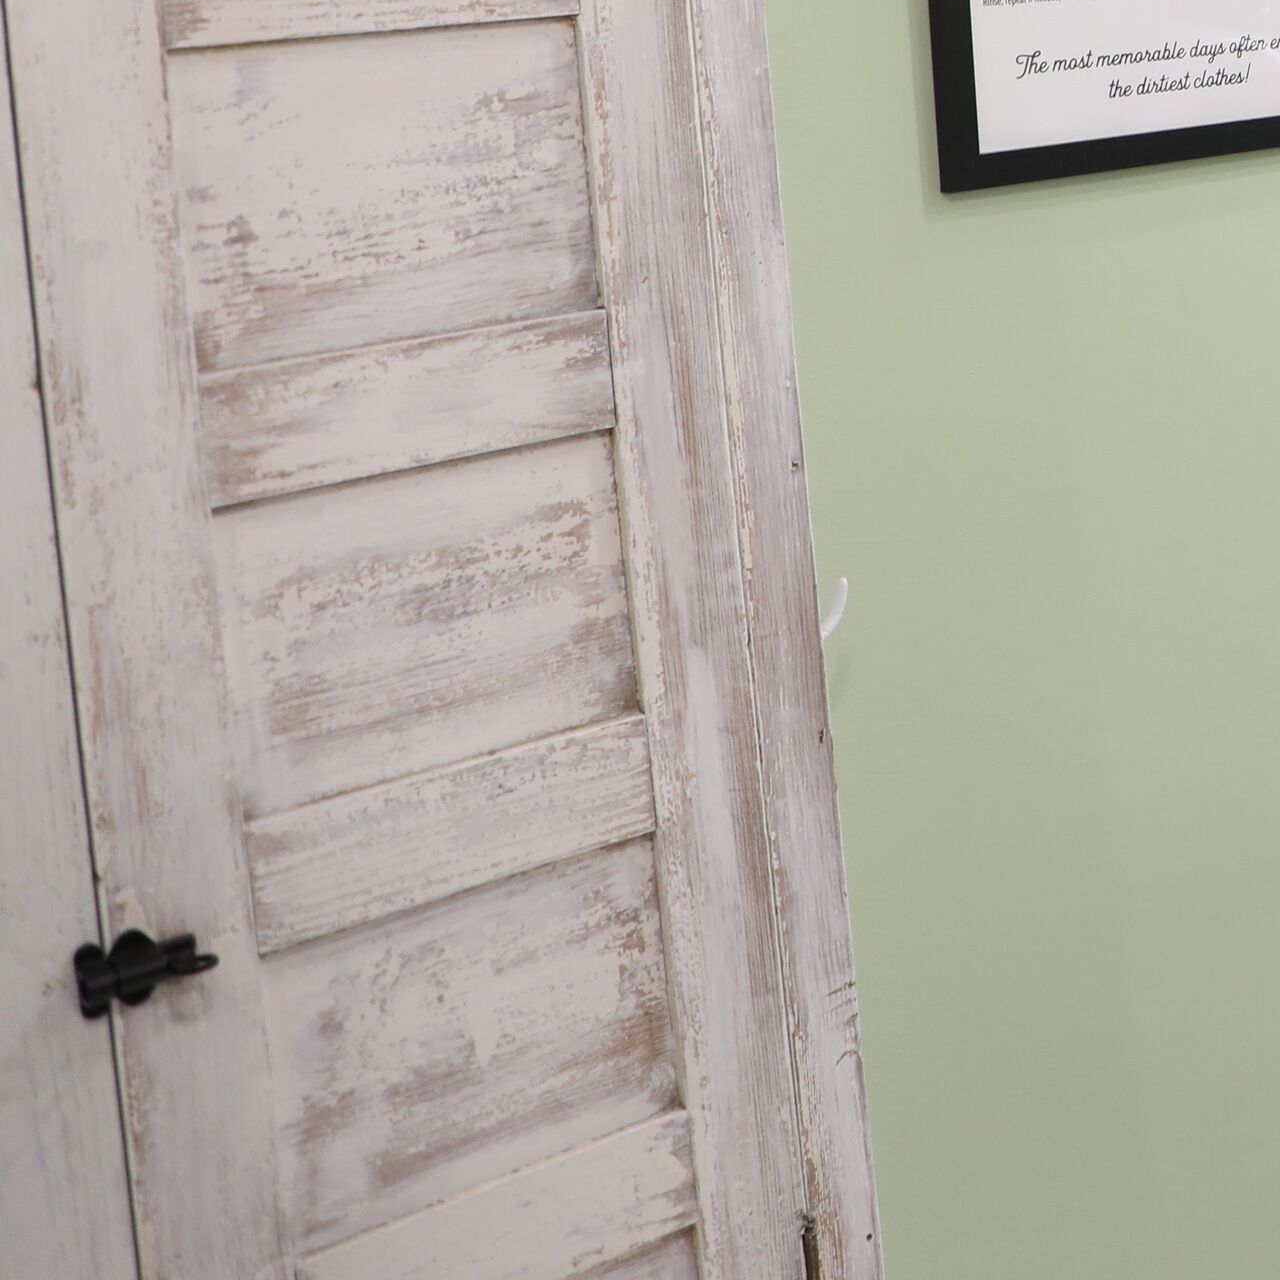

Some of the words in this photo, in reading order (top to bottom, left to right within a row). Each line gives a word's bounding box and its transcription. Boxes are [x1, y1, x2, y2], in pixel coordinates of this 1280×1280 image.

[1015, 51, 1049, 80] The
[1053, 51, 1093, 73] most
[1096, 42, 1185, 68] memorable
[1190, 41, 1227, 65] days
[1230, 34, 1267, 59] often
[1108, 77, 1133, 99] the
[1137, 70, 1191, 94] dirtiest
[1194, 63, 1251, 90] clothes!
